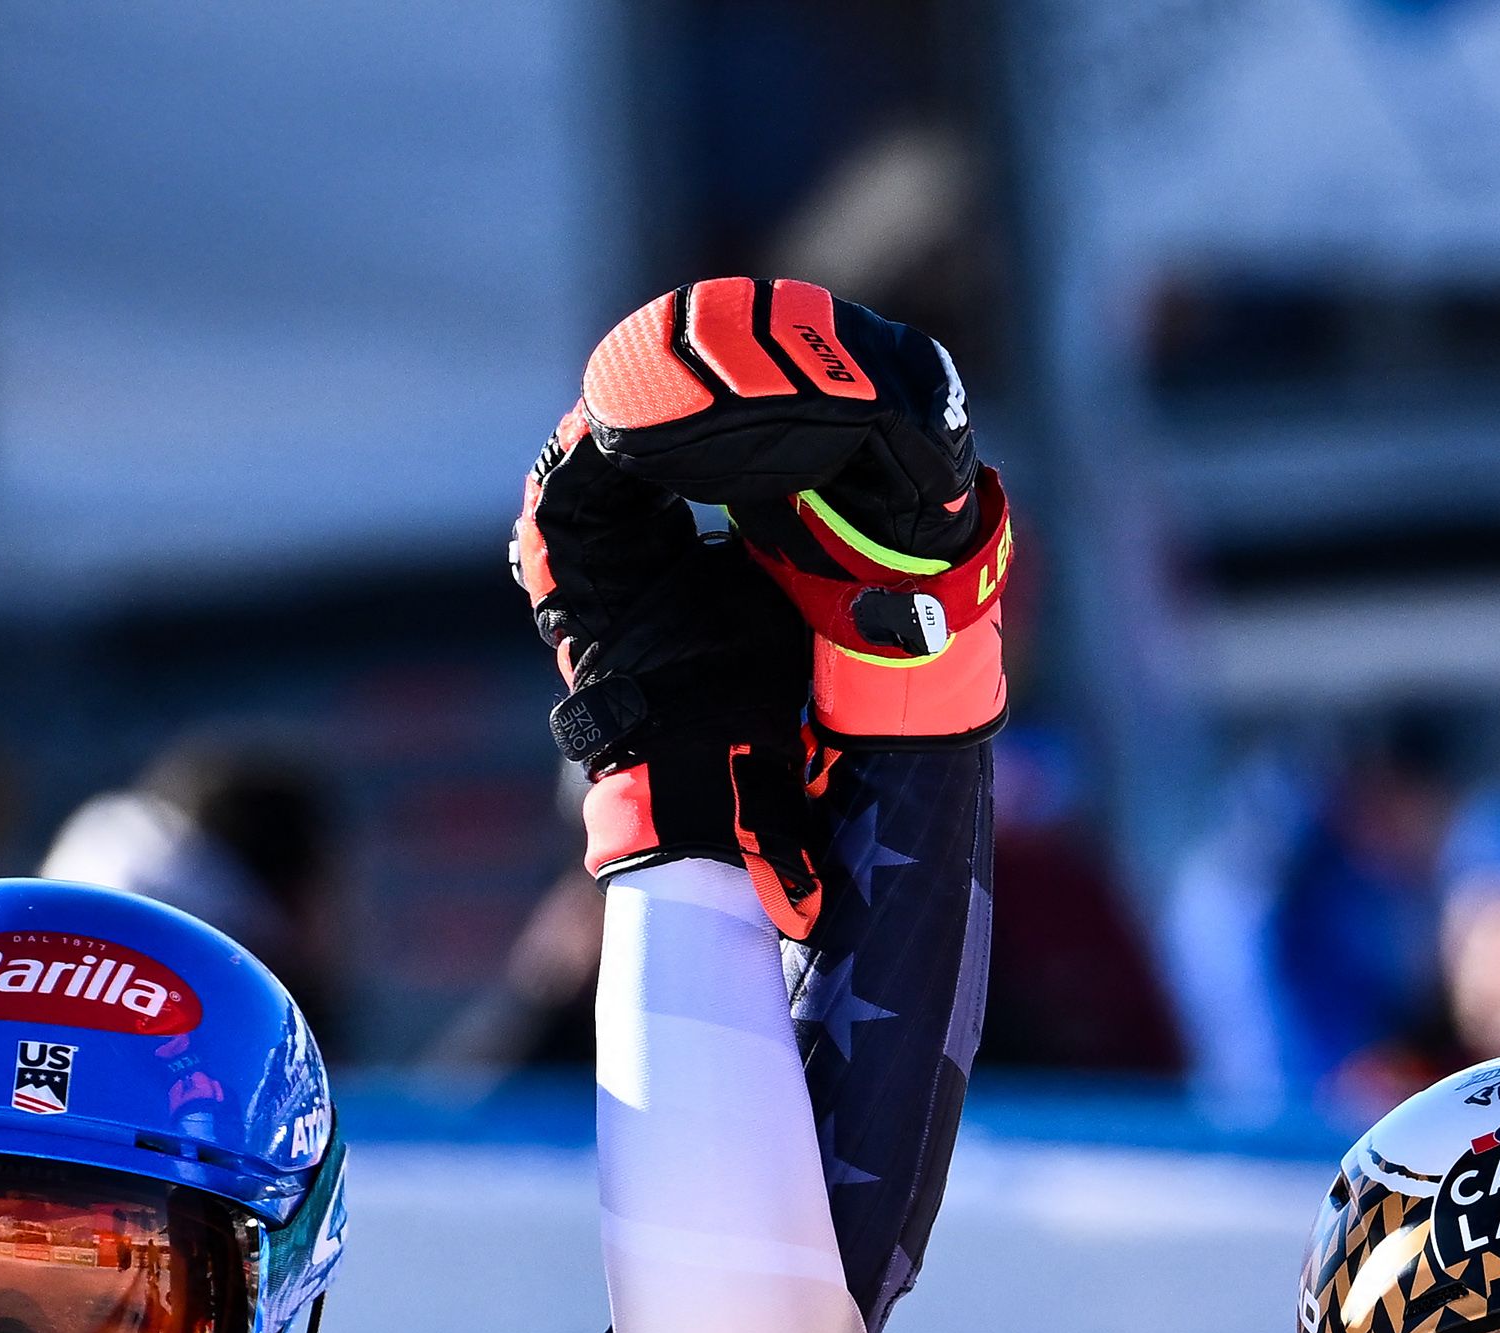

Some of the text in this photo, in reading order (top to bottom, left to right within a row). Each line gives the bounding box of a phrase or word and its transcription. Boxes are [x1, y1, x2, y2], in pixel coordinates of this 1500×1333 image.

[792, 323, 856, 384] racing
[924, 604, 937, 628] LEFT
[18, 1041, 72, 1070] US
